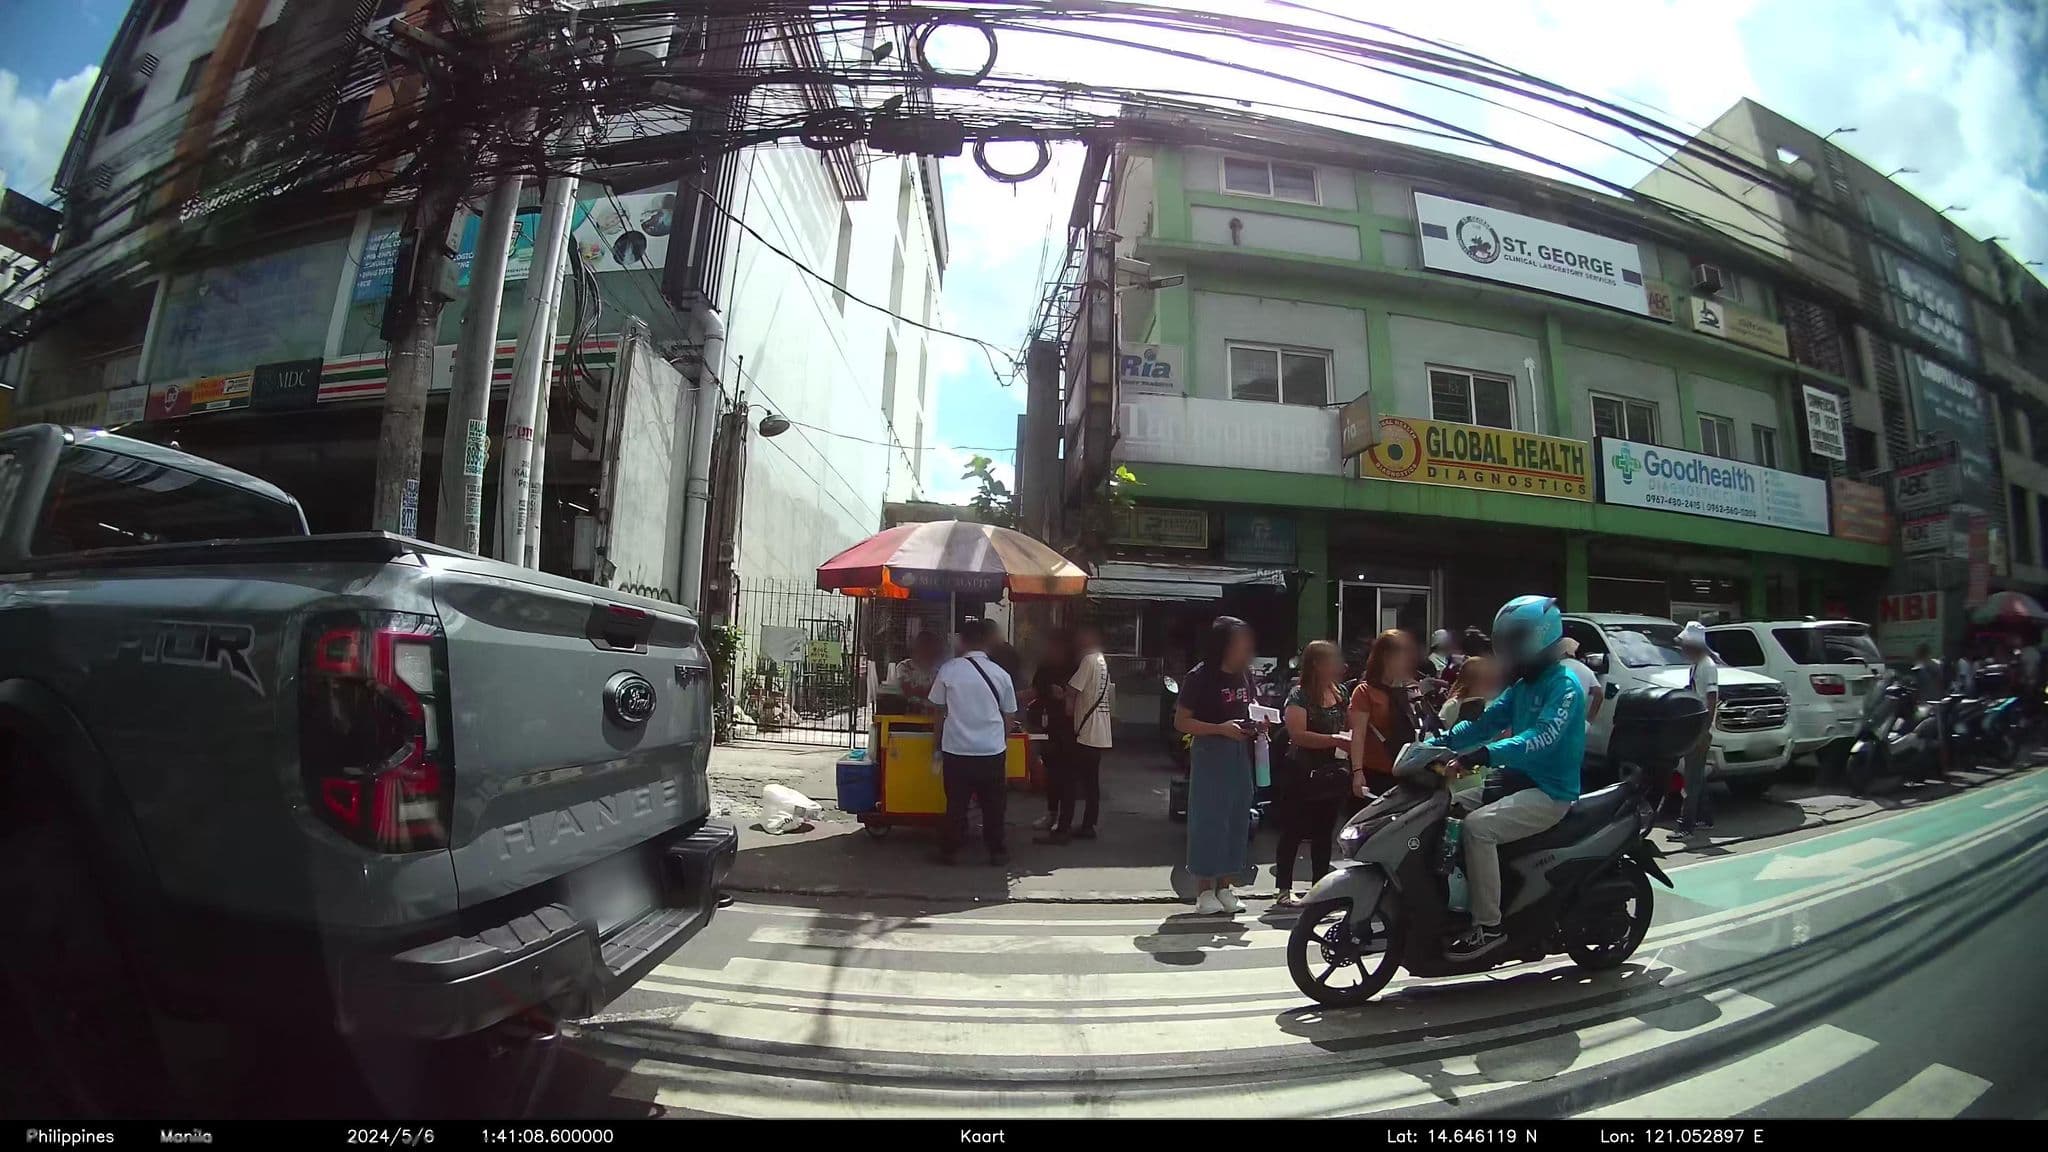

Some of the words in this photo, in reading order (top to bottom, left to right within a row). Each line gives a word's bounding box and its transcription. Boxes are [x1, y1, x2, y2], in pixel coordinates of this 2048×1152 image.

[1502, 235, 1532, 256] ST.
[1537, 244, 1615, 276] GEORGE
[1503, 253, 1538, 268] CLINICAL
[1121, 348, 1171, 378] Ria
[1425, 426, 1508, 466] GLOBAL
[1512, 436, 1585, 477] HEALTH
[1643, 450, 1755, 494] Goodhealth
[1427, 467, 1588, 496] DIAGNOSTICS
[627, 692, 652, 713] Ford
[1525, 706, 1570, 754] ANGKAS
[498, 778, 680, 861] RANGE
